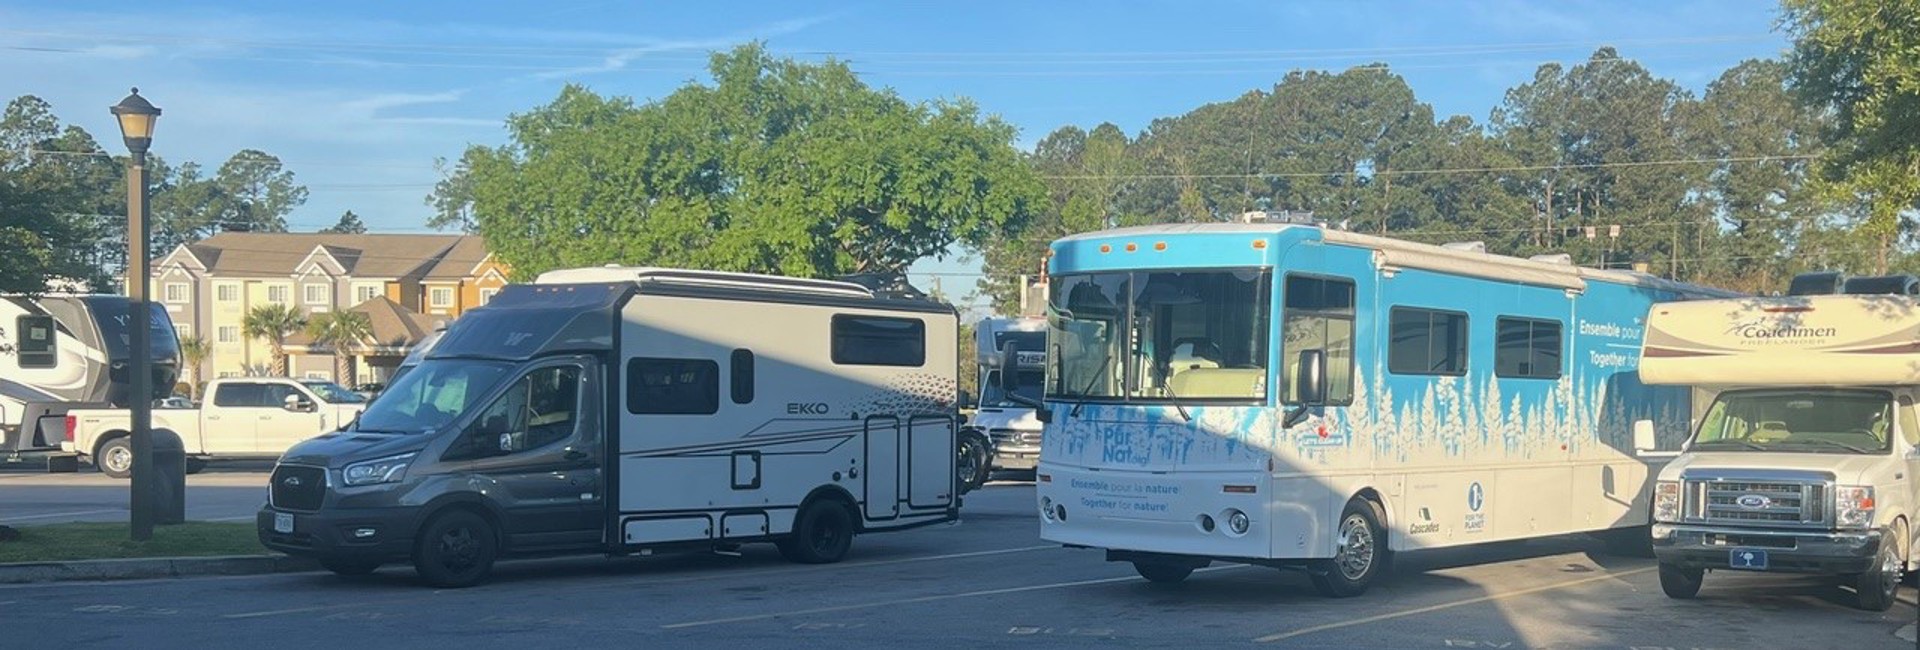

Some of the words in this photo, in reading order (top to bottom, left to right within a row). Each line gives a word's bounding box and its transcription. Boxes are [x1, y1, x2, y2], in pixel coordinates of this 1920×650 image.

[1580, 319, 1620, 338] Ensemble
[1743, 325, 1836, 338] Coachmen
[1590, 350, 1626, 368] Together
[787, 403, 829, 415] EKKO
[1071, 479, 1109, 490] Ensemble
[1111, 482, 1131, 493] pour
[1081, 497, 1117, 509] Together
[1119, 500, 1132, 509] for
[1410, 523, 1440, 535] Cascades
